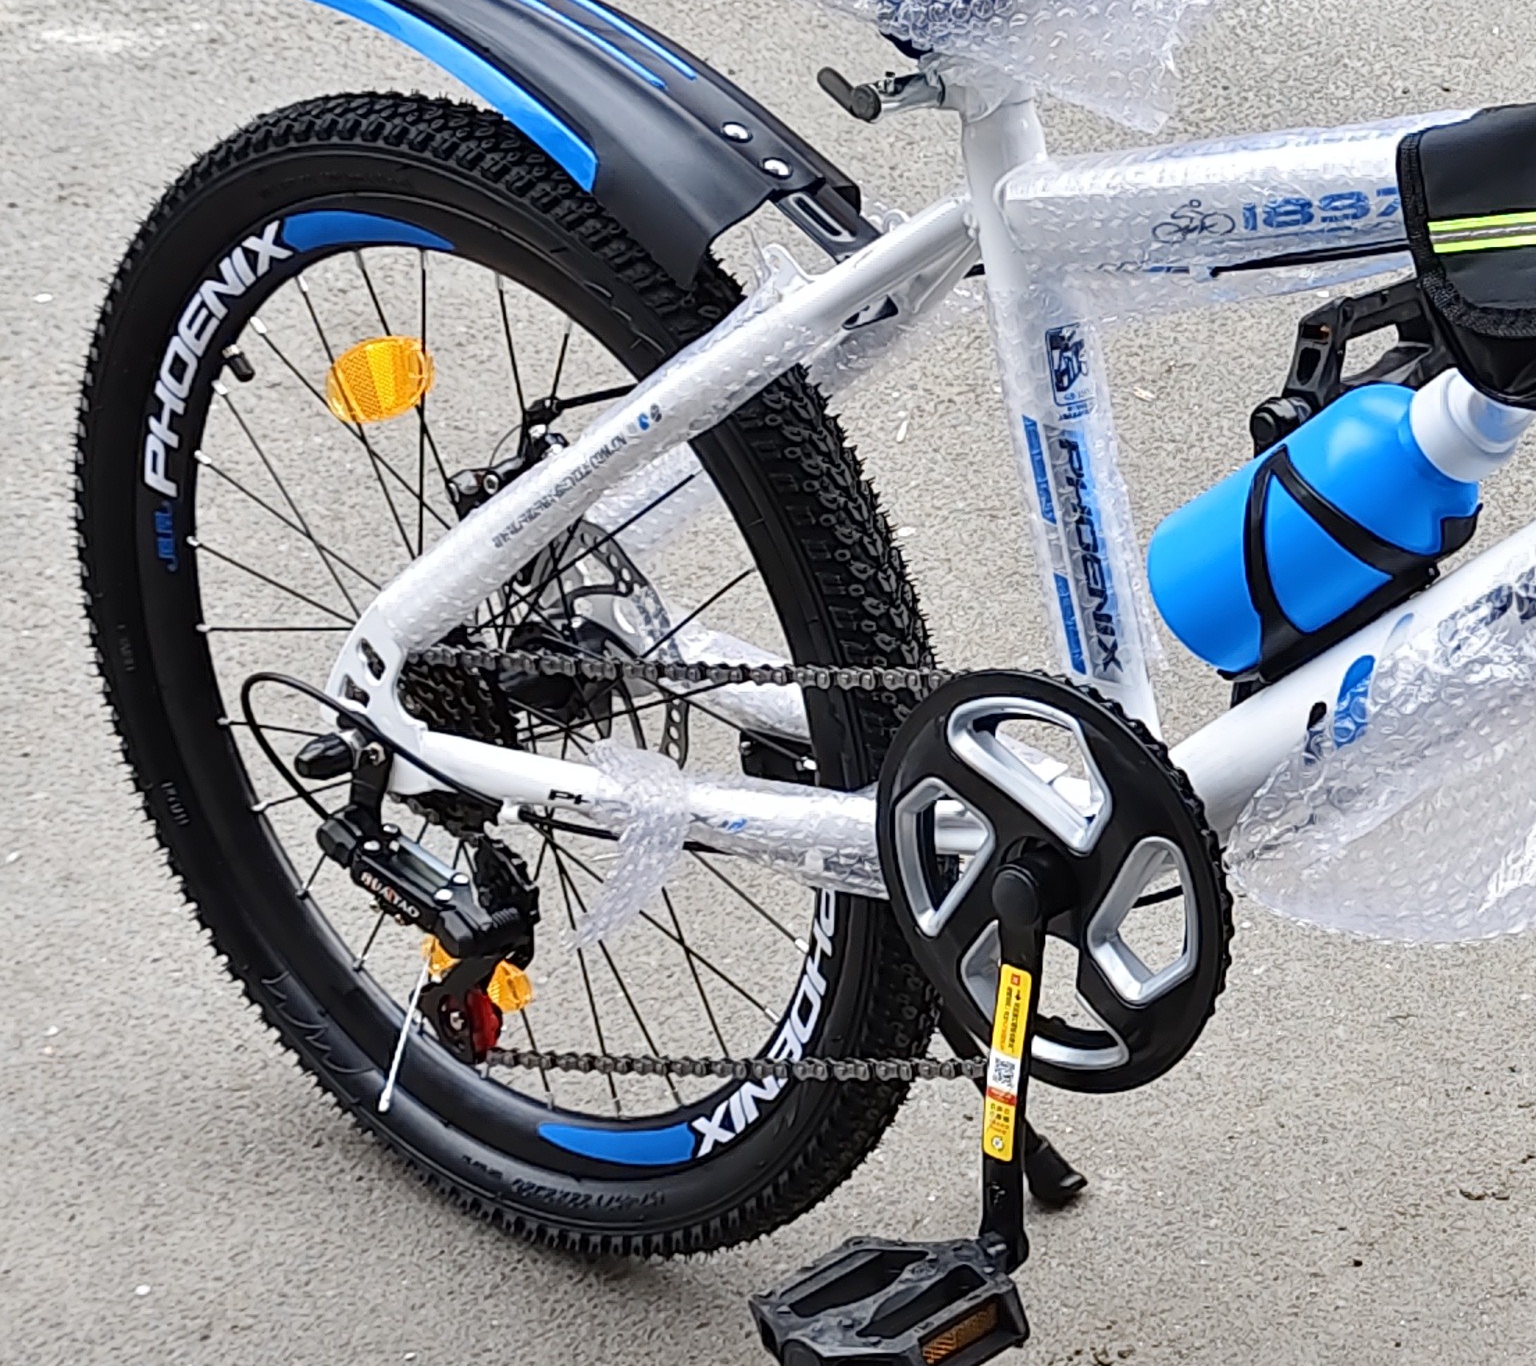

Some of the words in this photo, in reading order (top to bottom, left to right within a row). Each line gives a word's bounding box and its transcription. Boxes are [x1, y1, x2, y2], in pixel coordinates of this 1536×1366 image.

[1242, 187, 1400, 231] 1897
[145, 219, 294, 498] PHOENIX
[1058, 438, 1124, 673] PHOENIX
